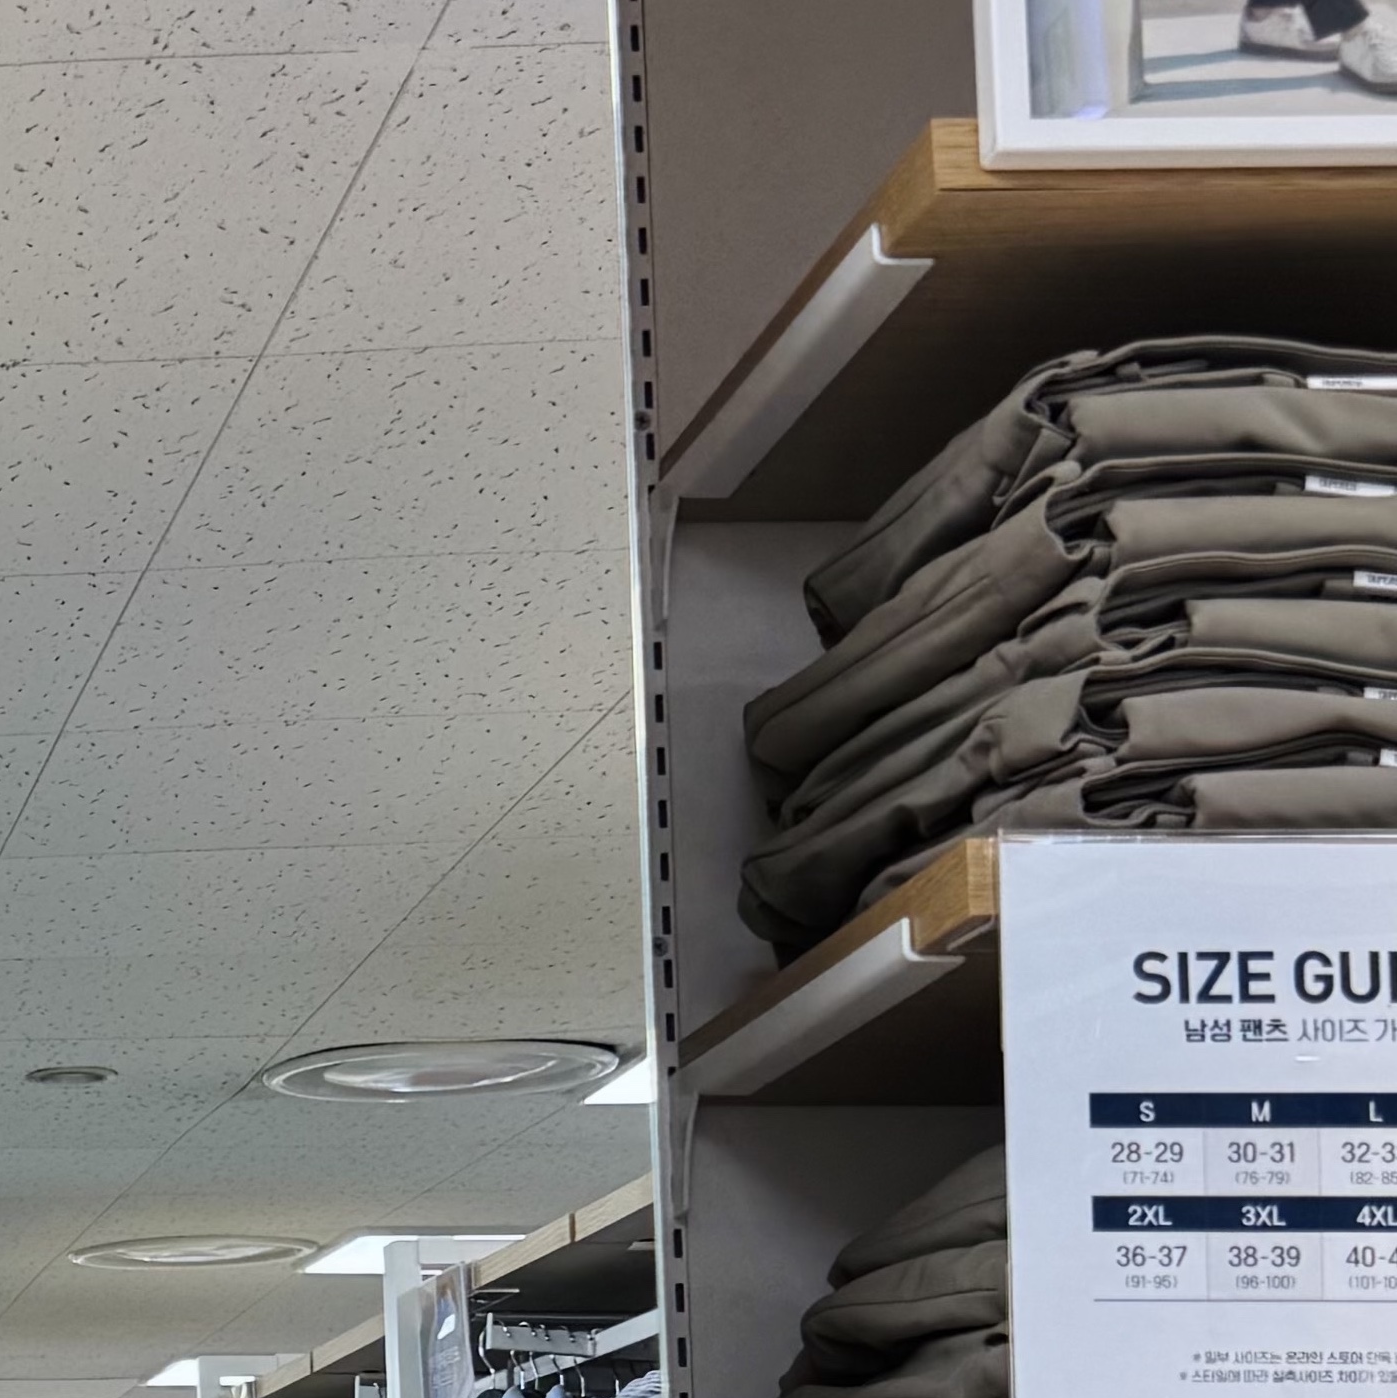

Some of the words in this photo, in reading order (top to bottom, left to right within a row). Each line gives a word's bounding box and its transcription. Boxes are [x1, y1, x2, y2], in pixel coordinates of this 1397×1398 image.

[1132, 951, 1275, 1005] SIZE
[1183, 1018, 1232, 1043] 남성
[1239, 1018, 1290, 1042] 팬츠
[1296, 1018, 1370, 1043] 사이즈
[1139, 1101, 1156, 1122] S
[1250, 1101, 1271, 1123] M
[1369, 1100, 1384, 1122] L
[1110, 1142, 1184, 1164] 28-29
[1227, 1142, 1296, 1164] 30-31
[1122, 1171, 1174, 1185] (71-74)
[1235, 1171, 1290, 1186] (76-79)
[1127, 1205, 1173, 1227] 2XL
[1241, 1205, 1287, 1227] 3XL
[1356, 1205, 1397, 1227] 4XL
[1115, 1246, 1188, 1268] 36-37
[1228, 1246, 1302, 1268] 38-39
[1125, 1275, 1178, 1290] (91-95)
[1235, 1275, 1296, 1290] (96-100)
[1285, 1351, 1323, 1365] 온라인
[1326, 1351, 1363, 1365] 스토어
